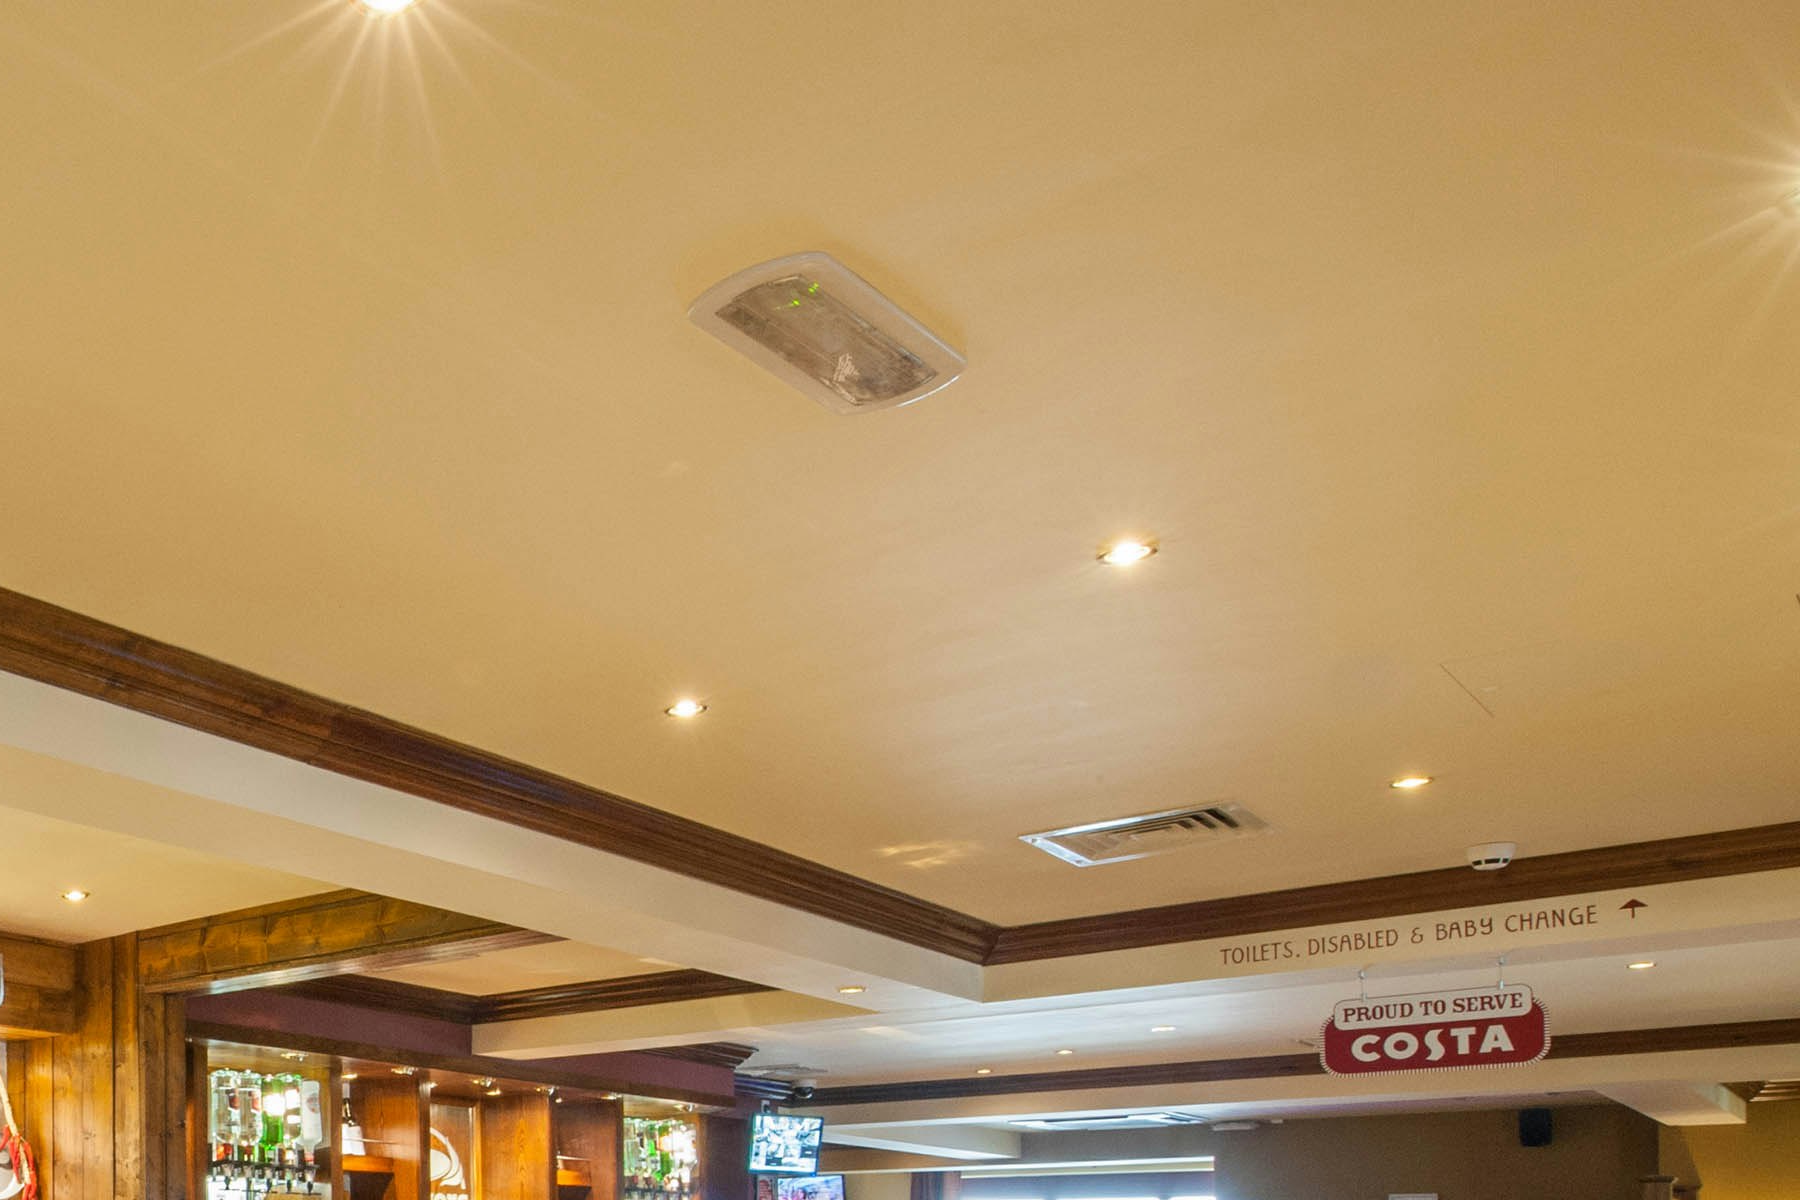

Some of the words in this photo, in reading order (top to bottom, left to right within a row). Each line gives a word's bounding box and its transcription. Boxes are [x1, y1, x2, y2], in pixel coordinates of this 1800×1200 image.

[1308, 928, 1399, 956] DISABLED
[1410, 927, 1424, 944] &
[1435, 916, 1494, 941] BABY
[1504, 904, 1598, 933] CHANGE
[1343, 1002, 1413, 1023] PROUD
[1419, 1000, 1446, 1016] TO
[1452, 992, 1523, 1014] SERVE
[1351, 1024, 1515, 1062] COSTA
